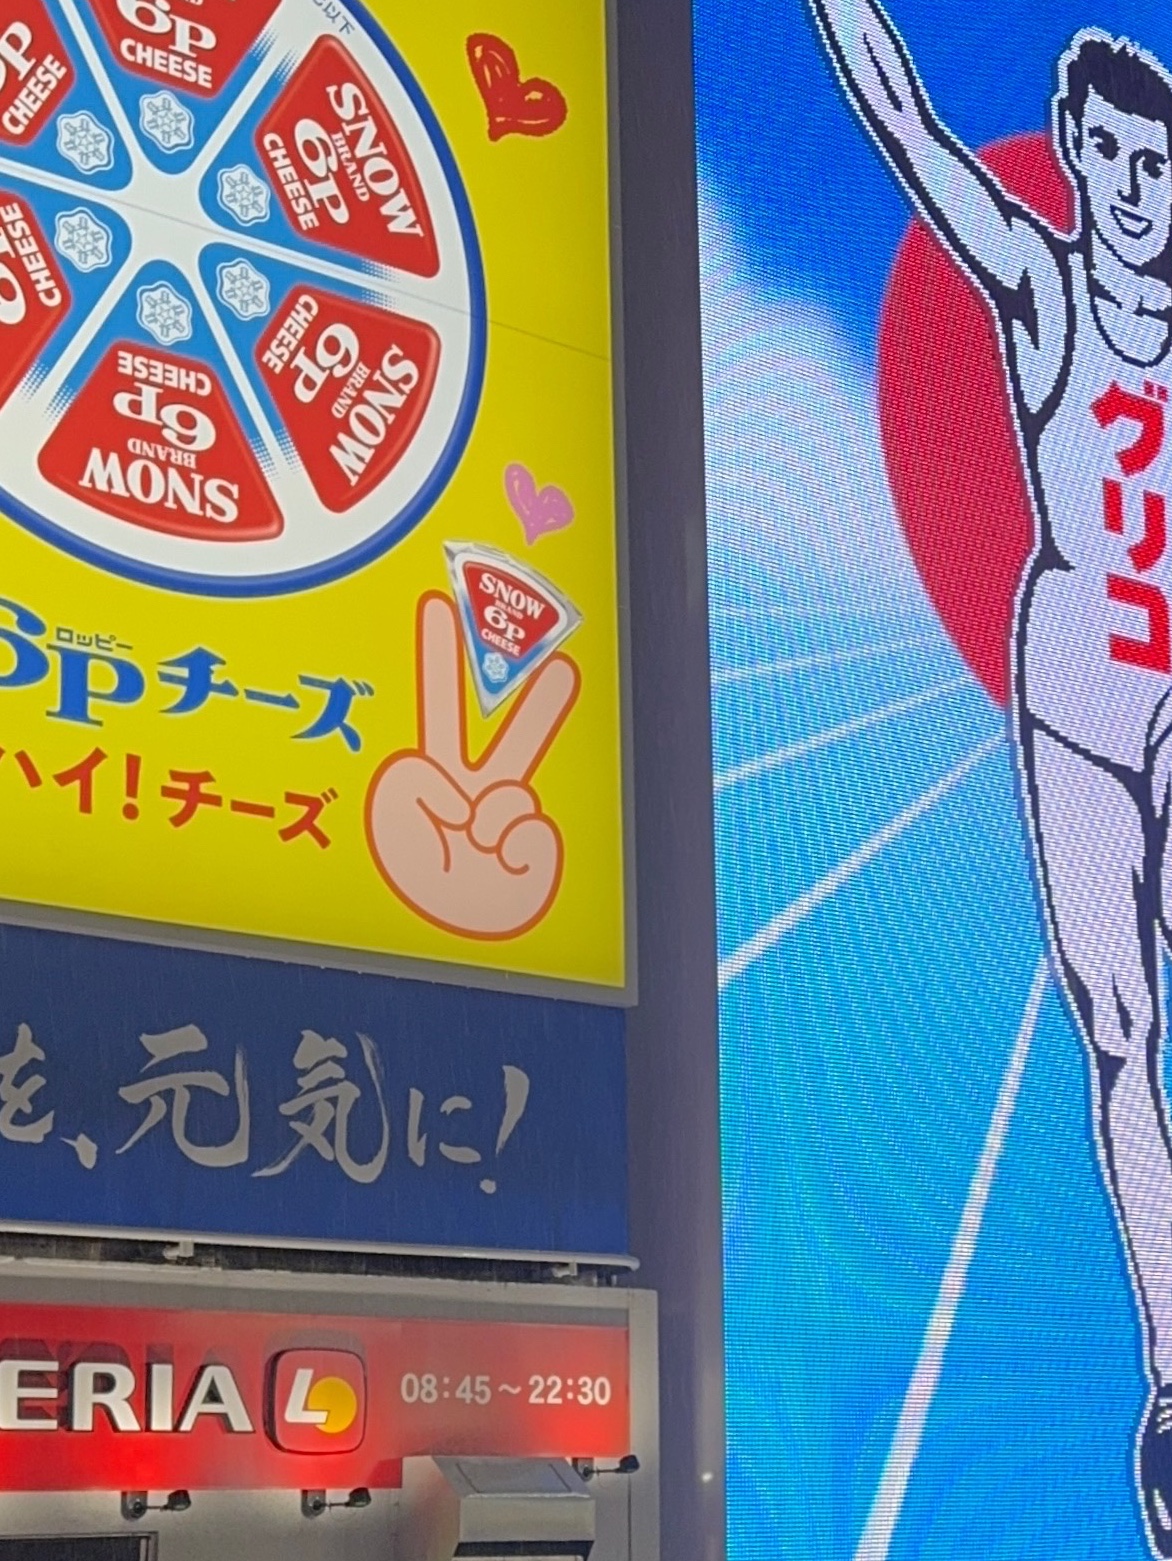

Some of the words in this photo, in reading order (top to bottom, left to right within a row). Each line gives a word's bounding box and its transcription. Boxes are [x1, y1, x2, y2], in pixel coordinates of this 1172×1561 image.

[2, 54, 68, 135] CHEESE
[119, 38, 213, 89] CHEESE
[263, 133, 319, 230] CHEESE
[294, 118, 349, 224] 6P
[326, 82, 424, 237] SNOW
[331, 132, 370, 201] BRAND
[1, 203, 62, 307] CHEESE
[262, 294, 319, 374] CHEESE
[293, 322, 361, 403] 6P
[117, 350, 212, 395] CHEESE
[331, 362, 370, 419] BRAND
[113, 382, 216, 452] 6P
[330, 344, 419, 486] SNOW
[78, 446, 239, 524] SNOW
[127, 437, 196, 469] BRAND
[1090, 380, 1172, 675] グリコ
[479, 573, 545, 619] SNOW
[484, 606, 525, 640] 6P
[56, 626, 133, 652] ロッピー
[481, 628, 521, 657] CHEESE
[0, 1360, 254, 1434] ERIA
